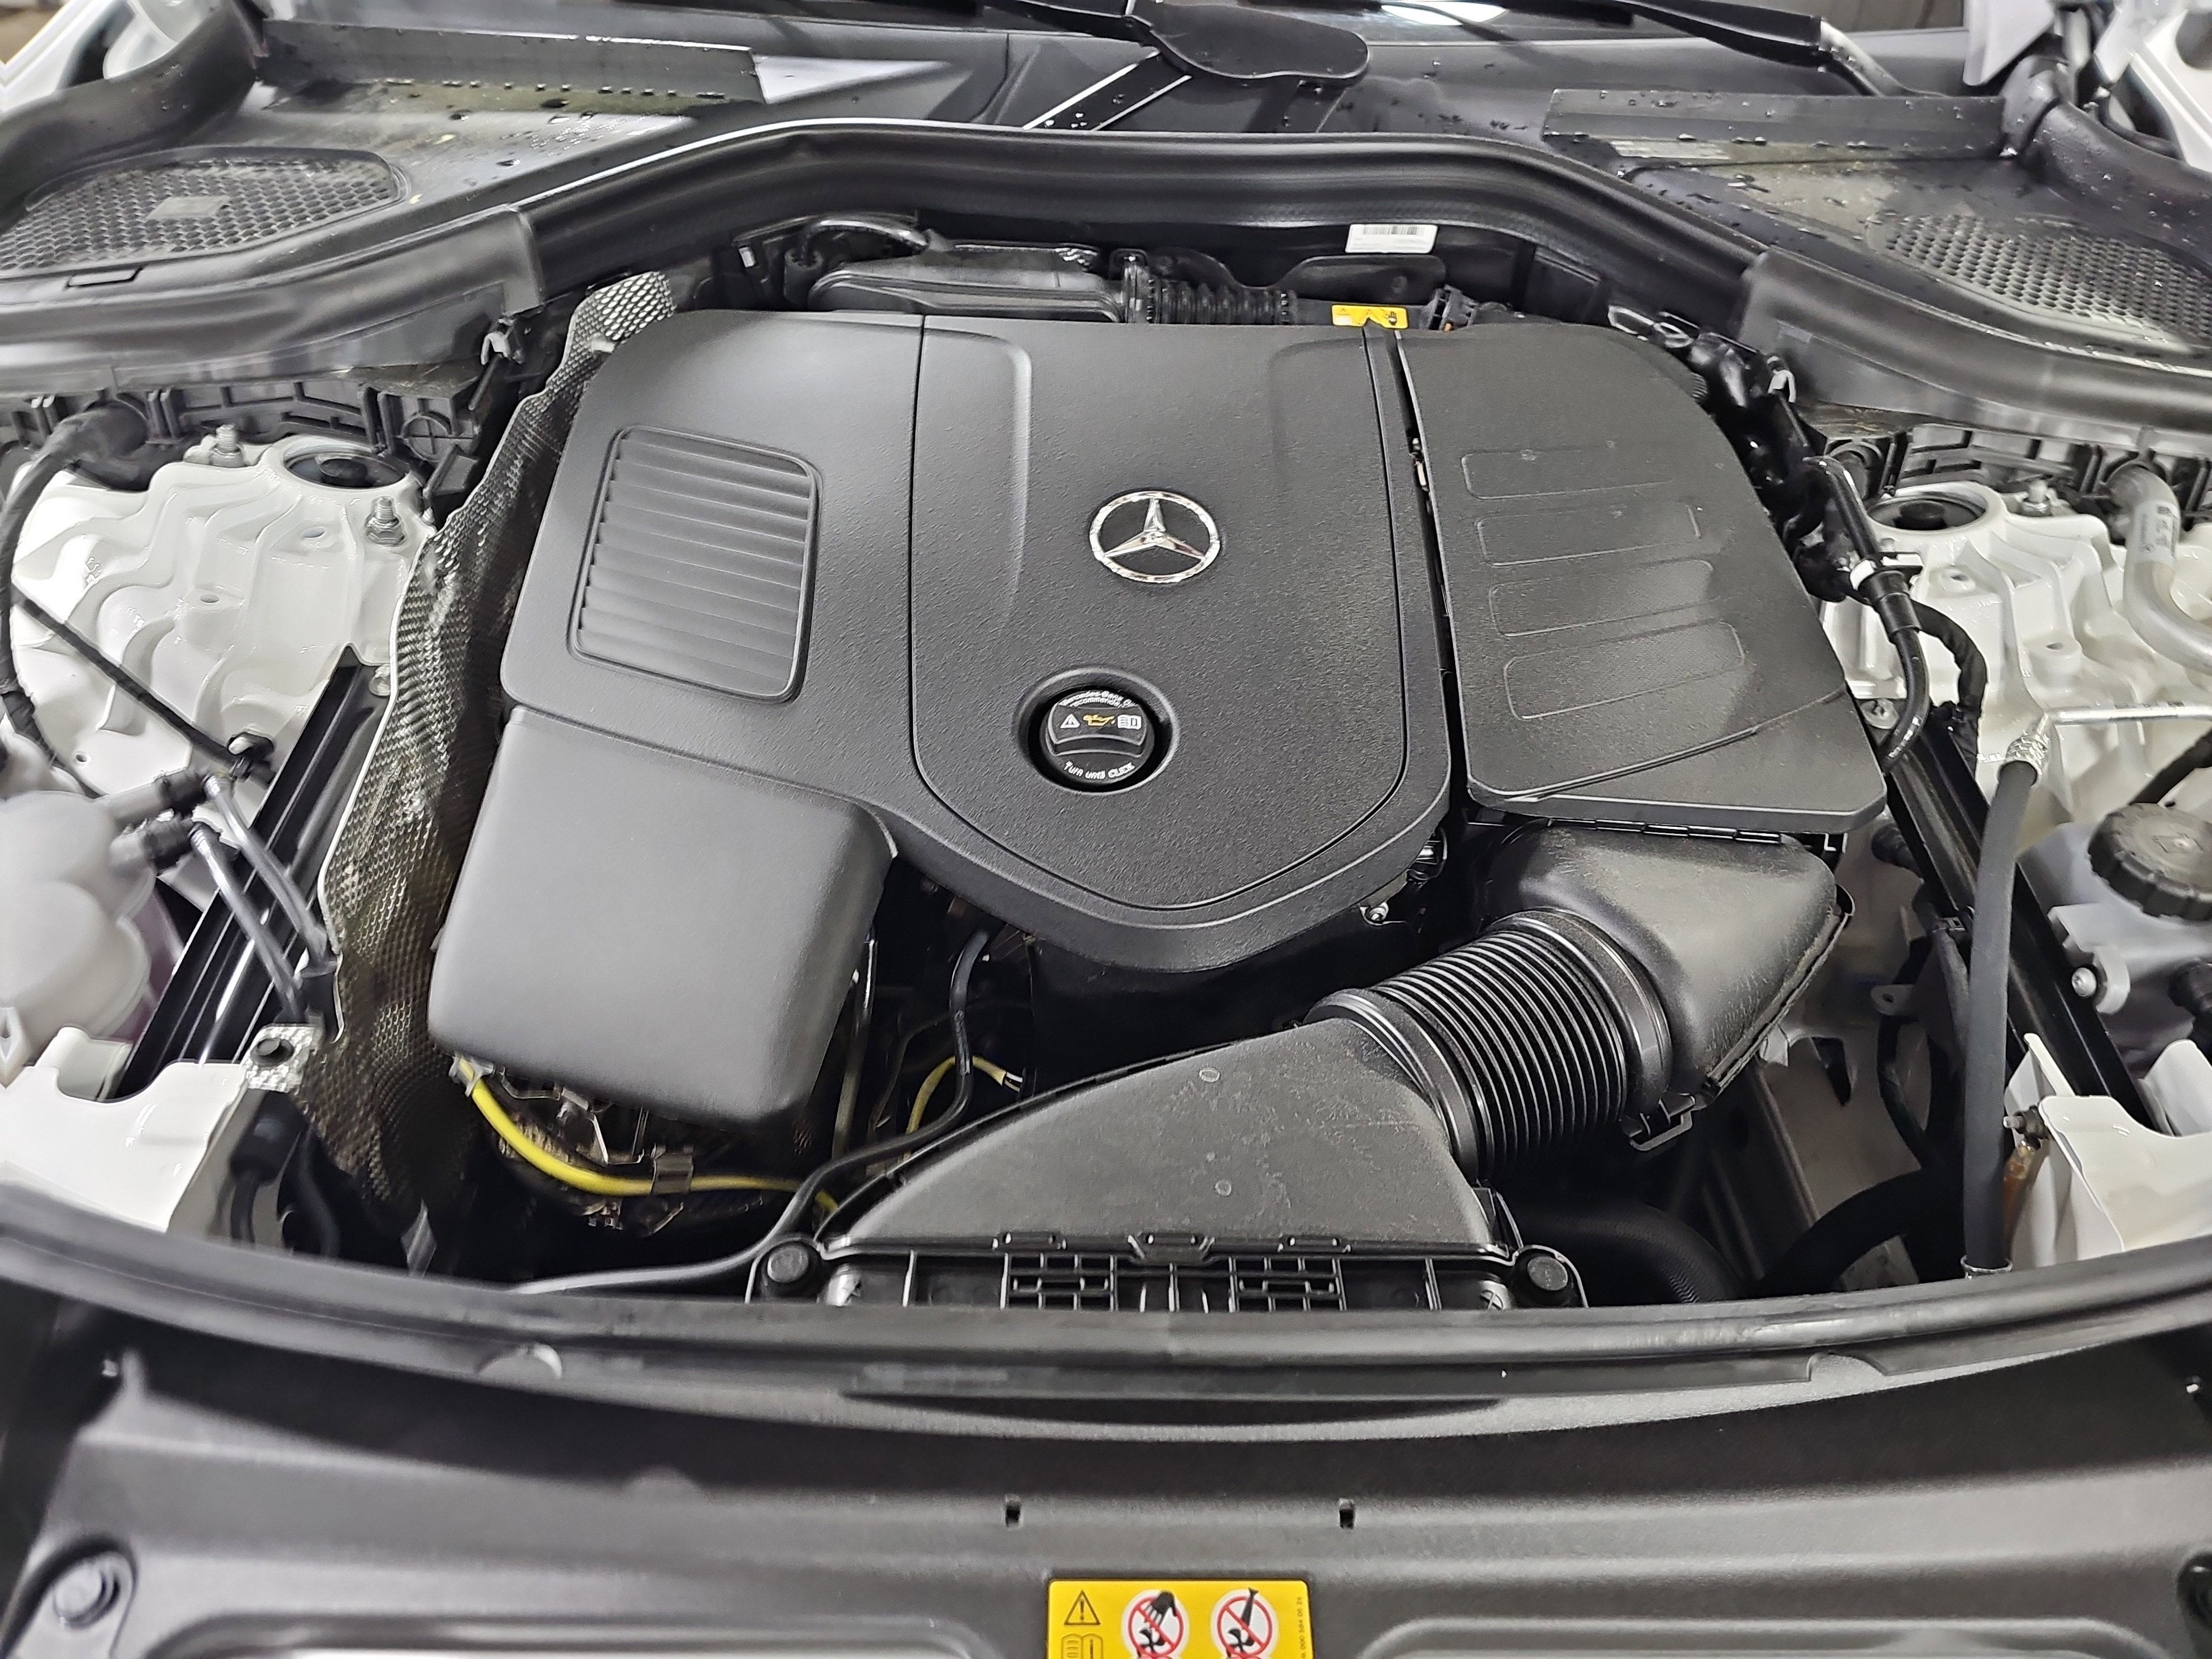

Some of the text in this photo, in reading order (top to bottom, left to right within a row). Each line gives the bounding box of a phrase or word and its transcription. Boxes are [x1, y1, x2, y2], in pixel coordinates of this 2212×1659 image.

[1064, 760, 1136, 780] Turn until CLICK
